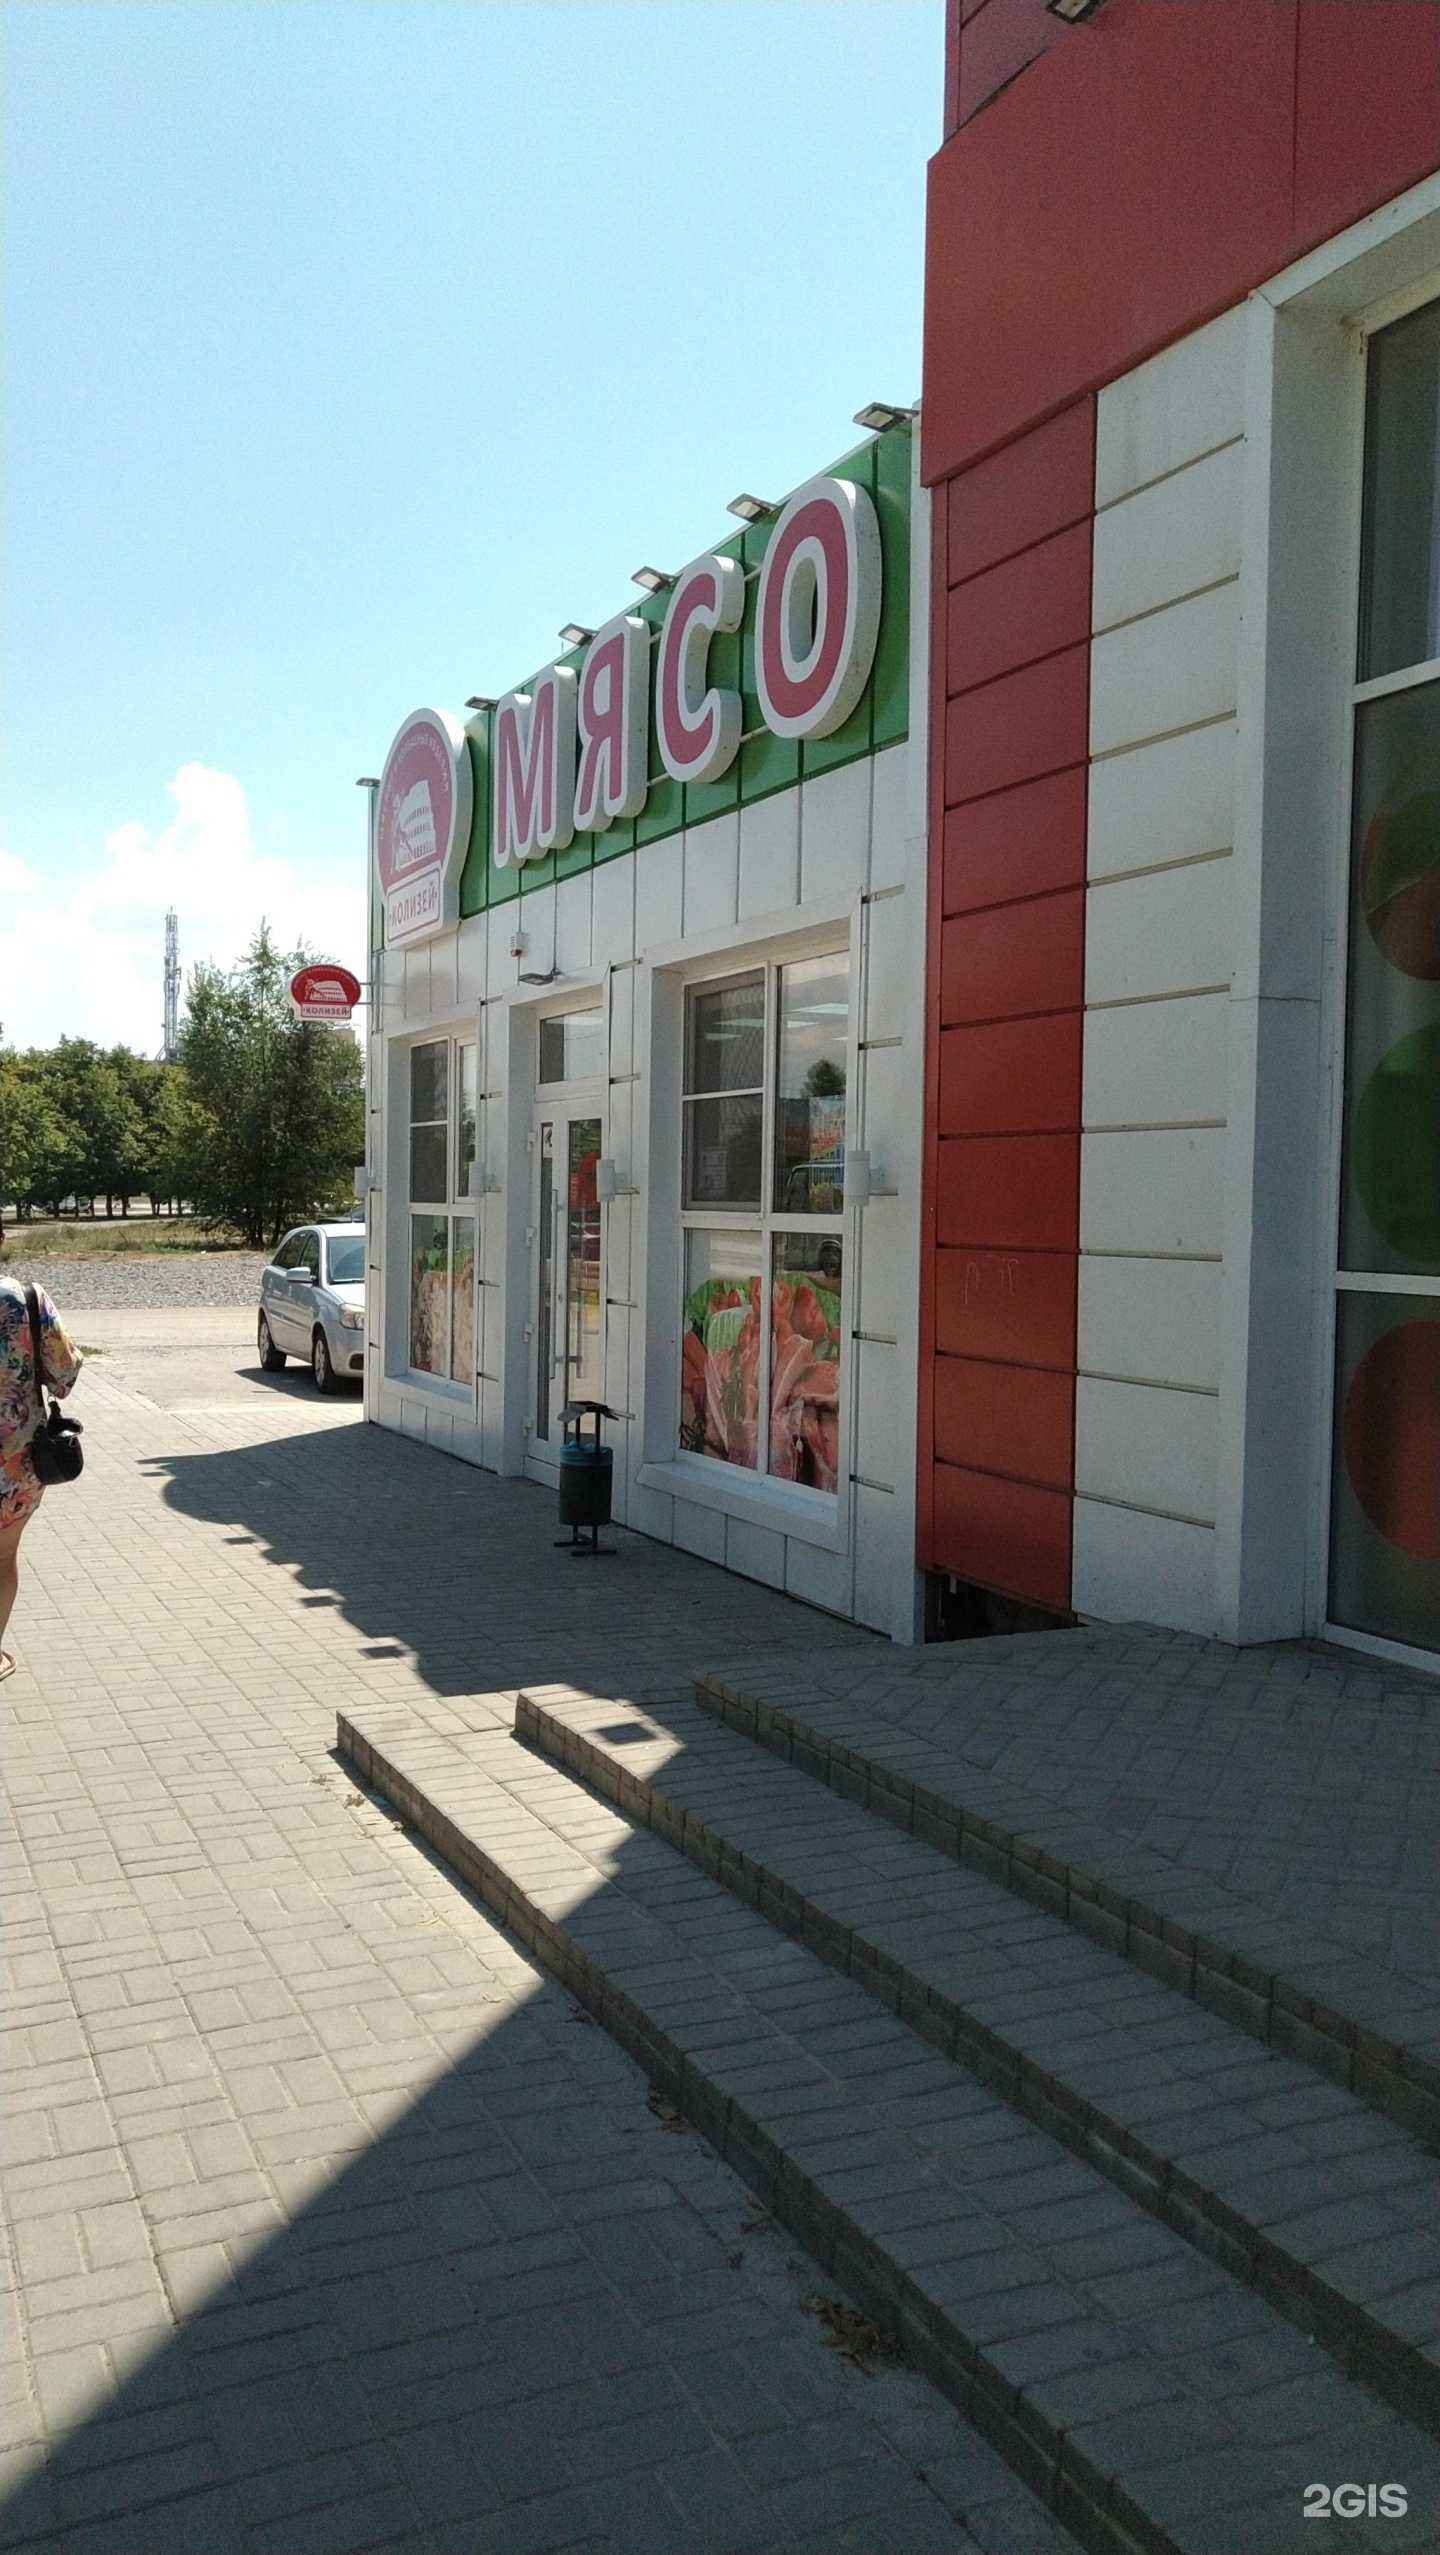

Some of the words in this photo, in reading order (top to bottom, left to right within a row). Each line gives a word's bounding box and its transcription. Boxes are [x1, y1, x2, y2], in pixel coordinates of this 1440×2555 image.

[494, 477, 881, 868] МЯСО
[390, 881, 437, 927] КОЛИЗЕЙ
[305, 1006, 348, 1016] КОЛИЗЕЙ
